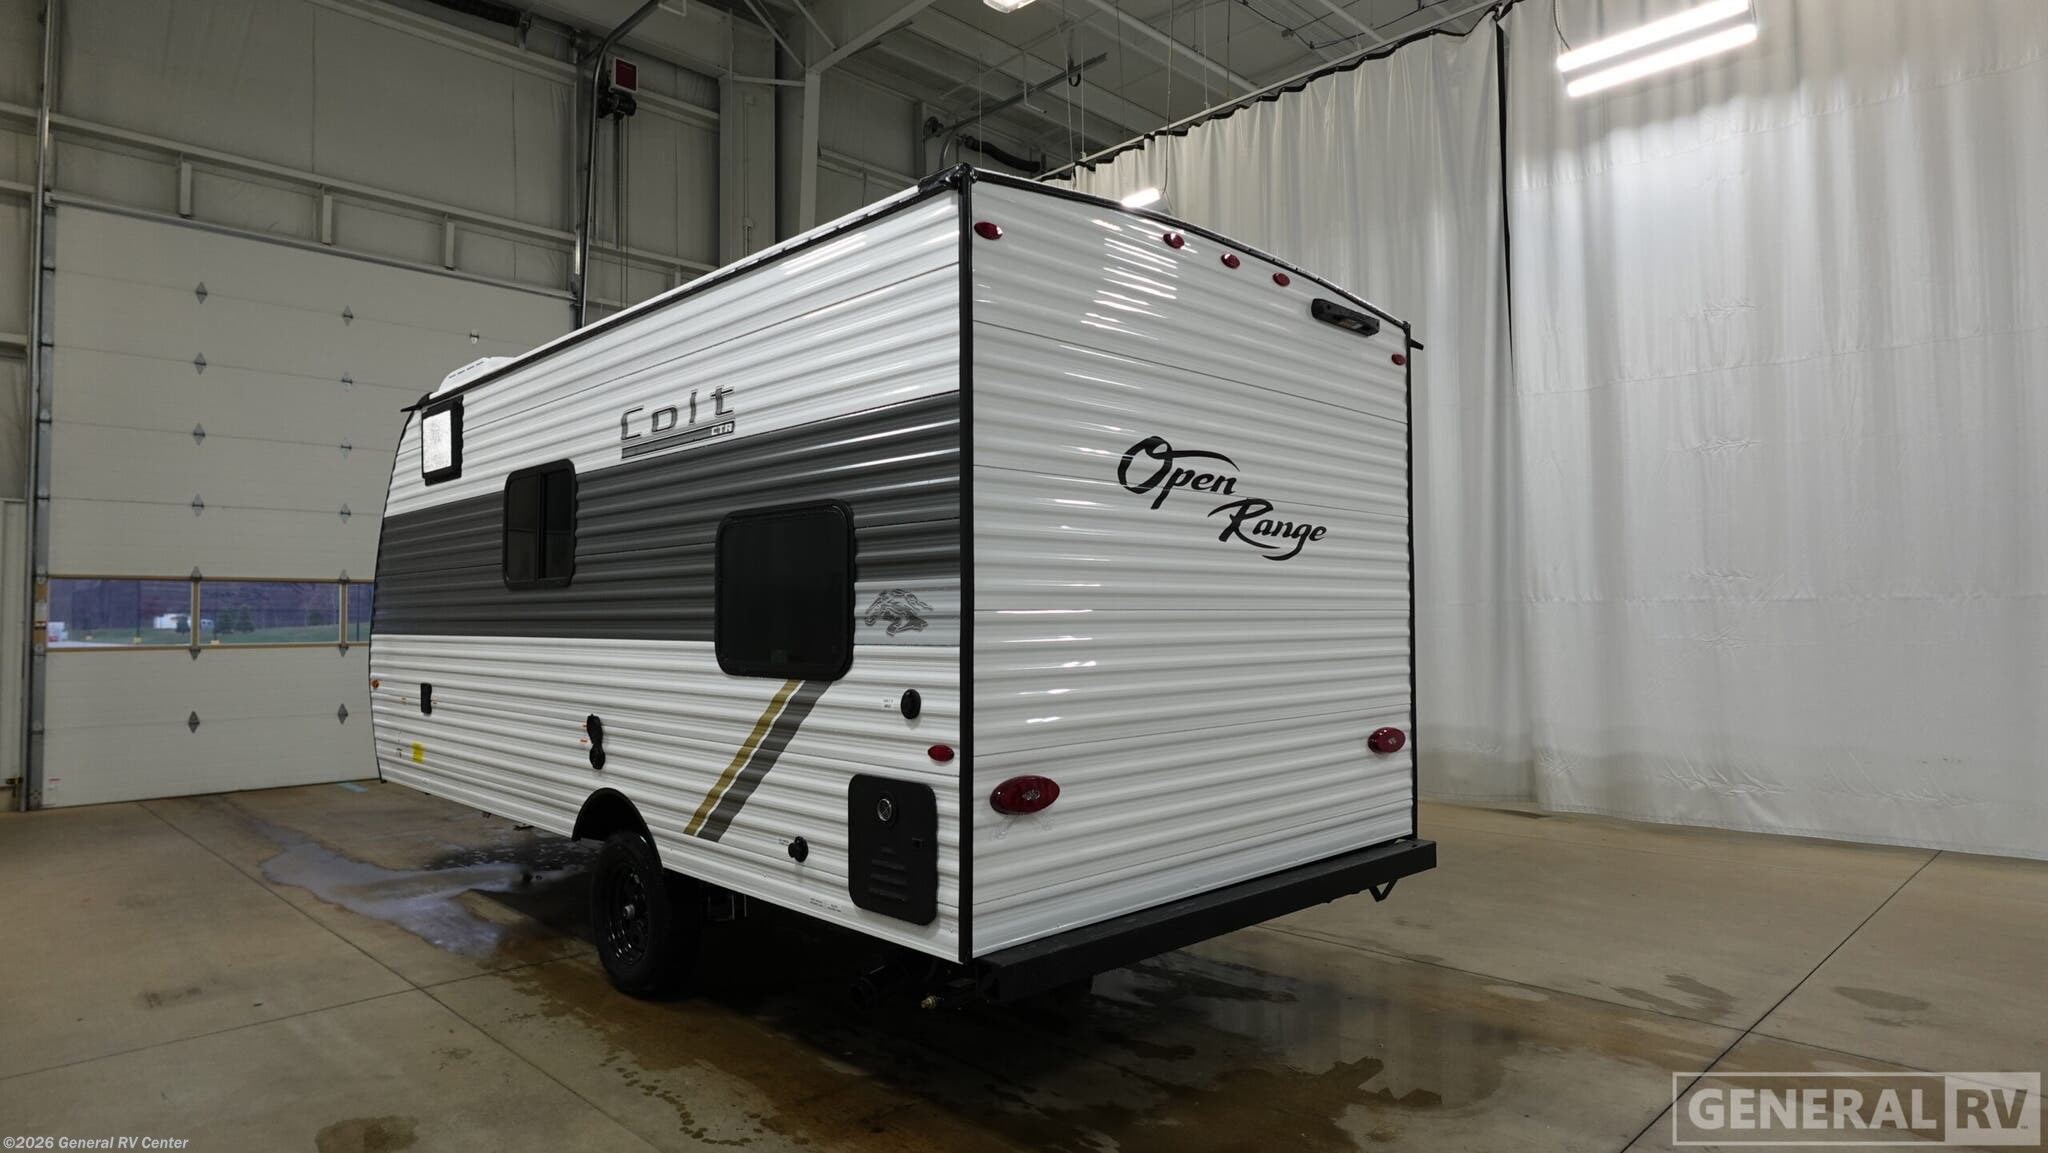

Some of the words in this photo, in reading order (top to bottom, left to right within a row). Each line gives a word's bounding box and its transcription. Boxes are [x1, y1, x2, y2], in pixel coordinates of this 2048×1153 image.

[621, 385, 735, 441] Colt
[711, 423, 733, 436] CTR
[1117, 435, 1240, 510] Open
[1207, 498, 1328, 561] Range
